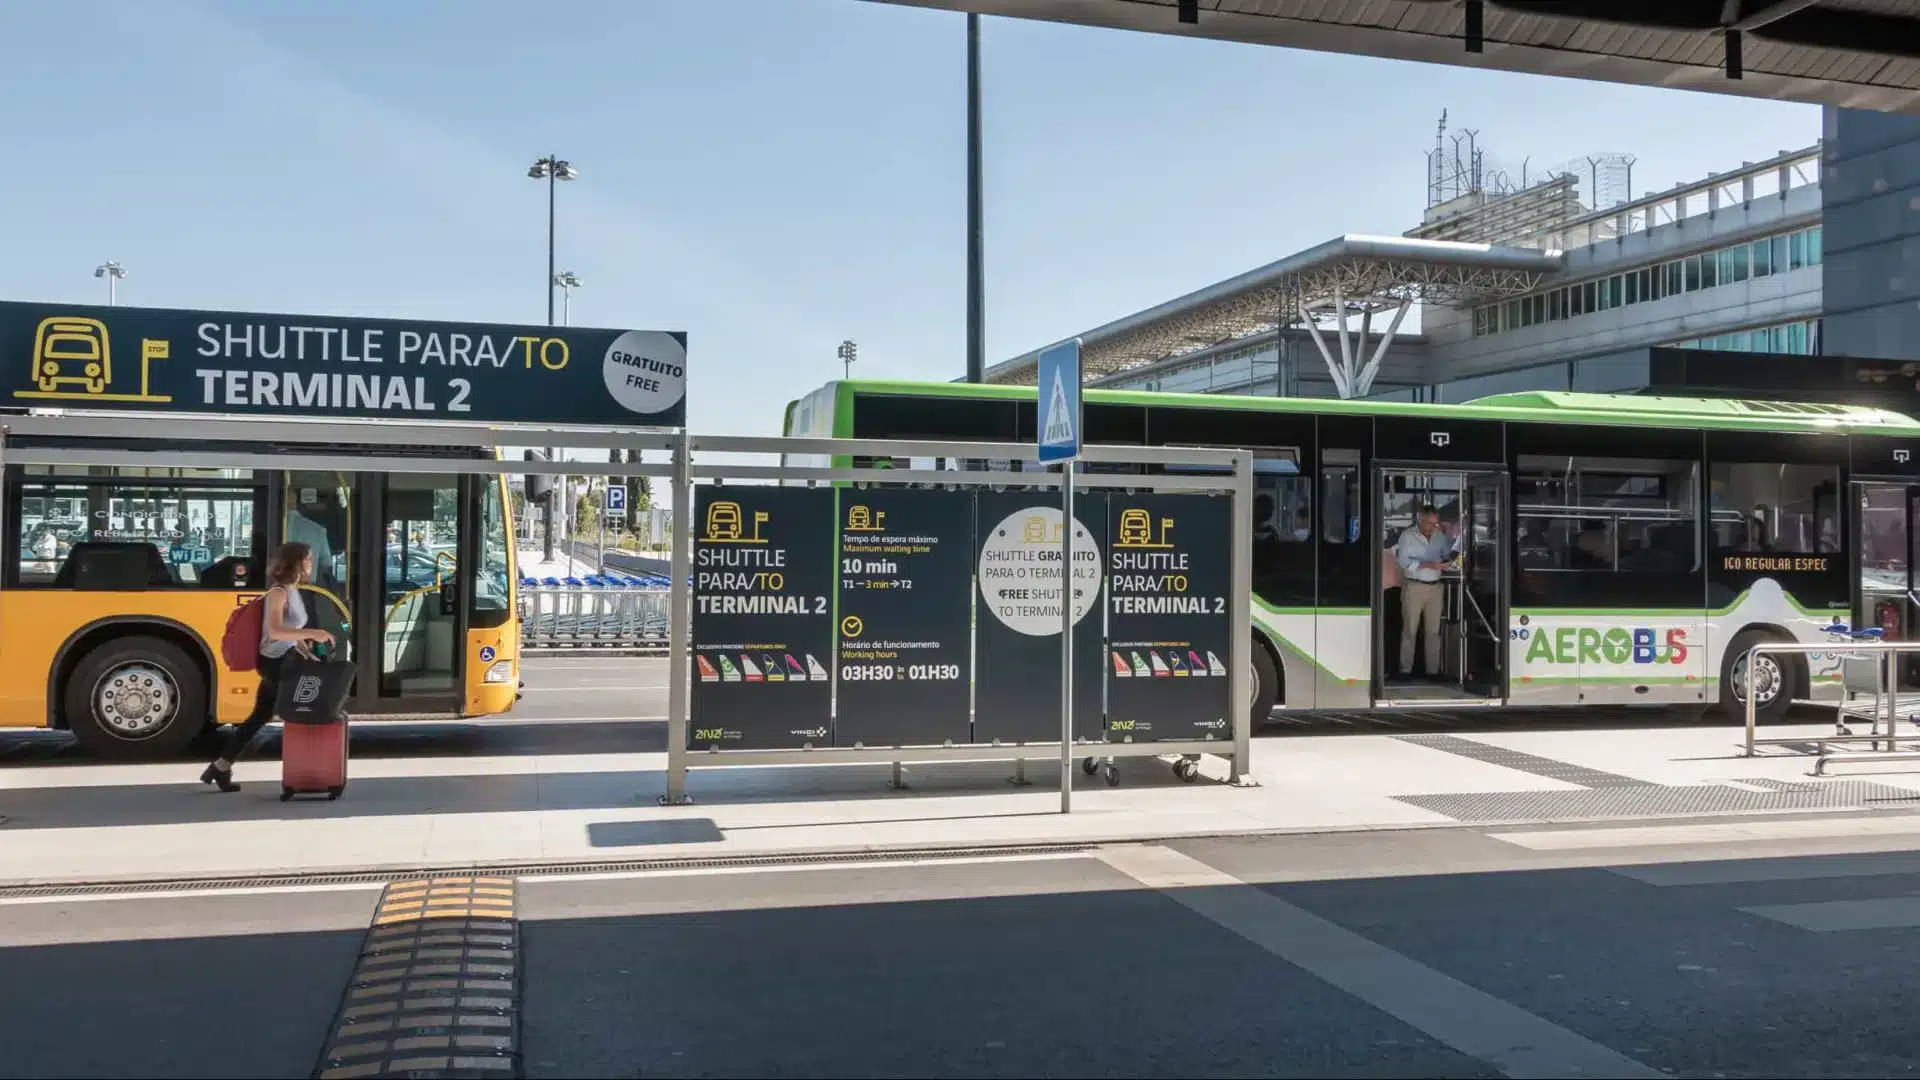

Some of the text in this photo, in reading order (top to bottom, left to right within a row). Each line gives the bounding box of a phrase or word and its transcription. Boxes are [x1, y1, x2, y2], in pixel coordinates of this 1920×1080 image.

[197, 322, 570, 370] SHUTTLE PARA/TO
[611, 350, 683, 378] GRATUITO
[196, 369, 472, 412] TERMINAL 2
[625, 374, 660, 393] FREE
[610, 488, 623, 507] P
[843, 535, 939, 545] Tempo de espera máximo
[698, 548, 785, 567] SHUTTLE
[843, 544, 931, 554] Maximum waiting time
[986, 550, 1035, 561] SHUTTLE
[842, 558, 897, 574] 10 min
[1112, 552, 1188, 570] SHUTTLE
[1745, 557, 1791, 571] REGULAR
[1795, 558, 1828, 571] ESPEC
[699, 572, 784, 591] PARA/TO
[986, 568, 1095, 579] PARA O TERMIAL 2
[843, 580, 912, 589] T1 3 min T2
[1113, 575, 1188, 592] PARA/TO
[1002, 588, 1081, 600] FREE SHUTE
[697, 595, 827, 614] TERMINAL 2
[999, 606, 1014, 616] TO
[1076, 606, 1082, 617] 2
[1112, 597, 1225, 614] TERMINAL 2
[842, 641, 940, 649] Horário de funcionamento
[1525, 627, 1688, 664] AEROBUS
[842, 650, 898, 660] Working hours
[842, 665, 894, 681] 03H30
[909, 664, 960, 680] 01H30
[293, 674, 321, 703] B
